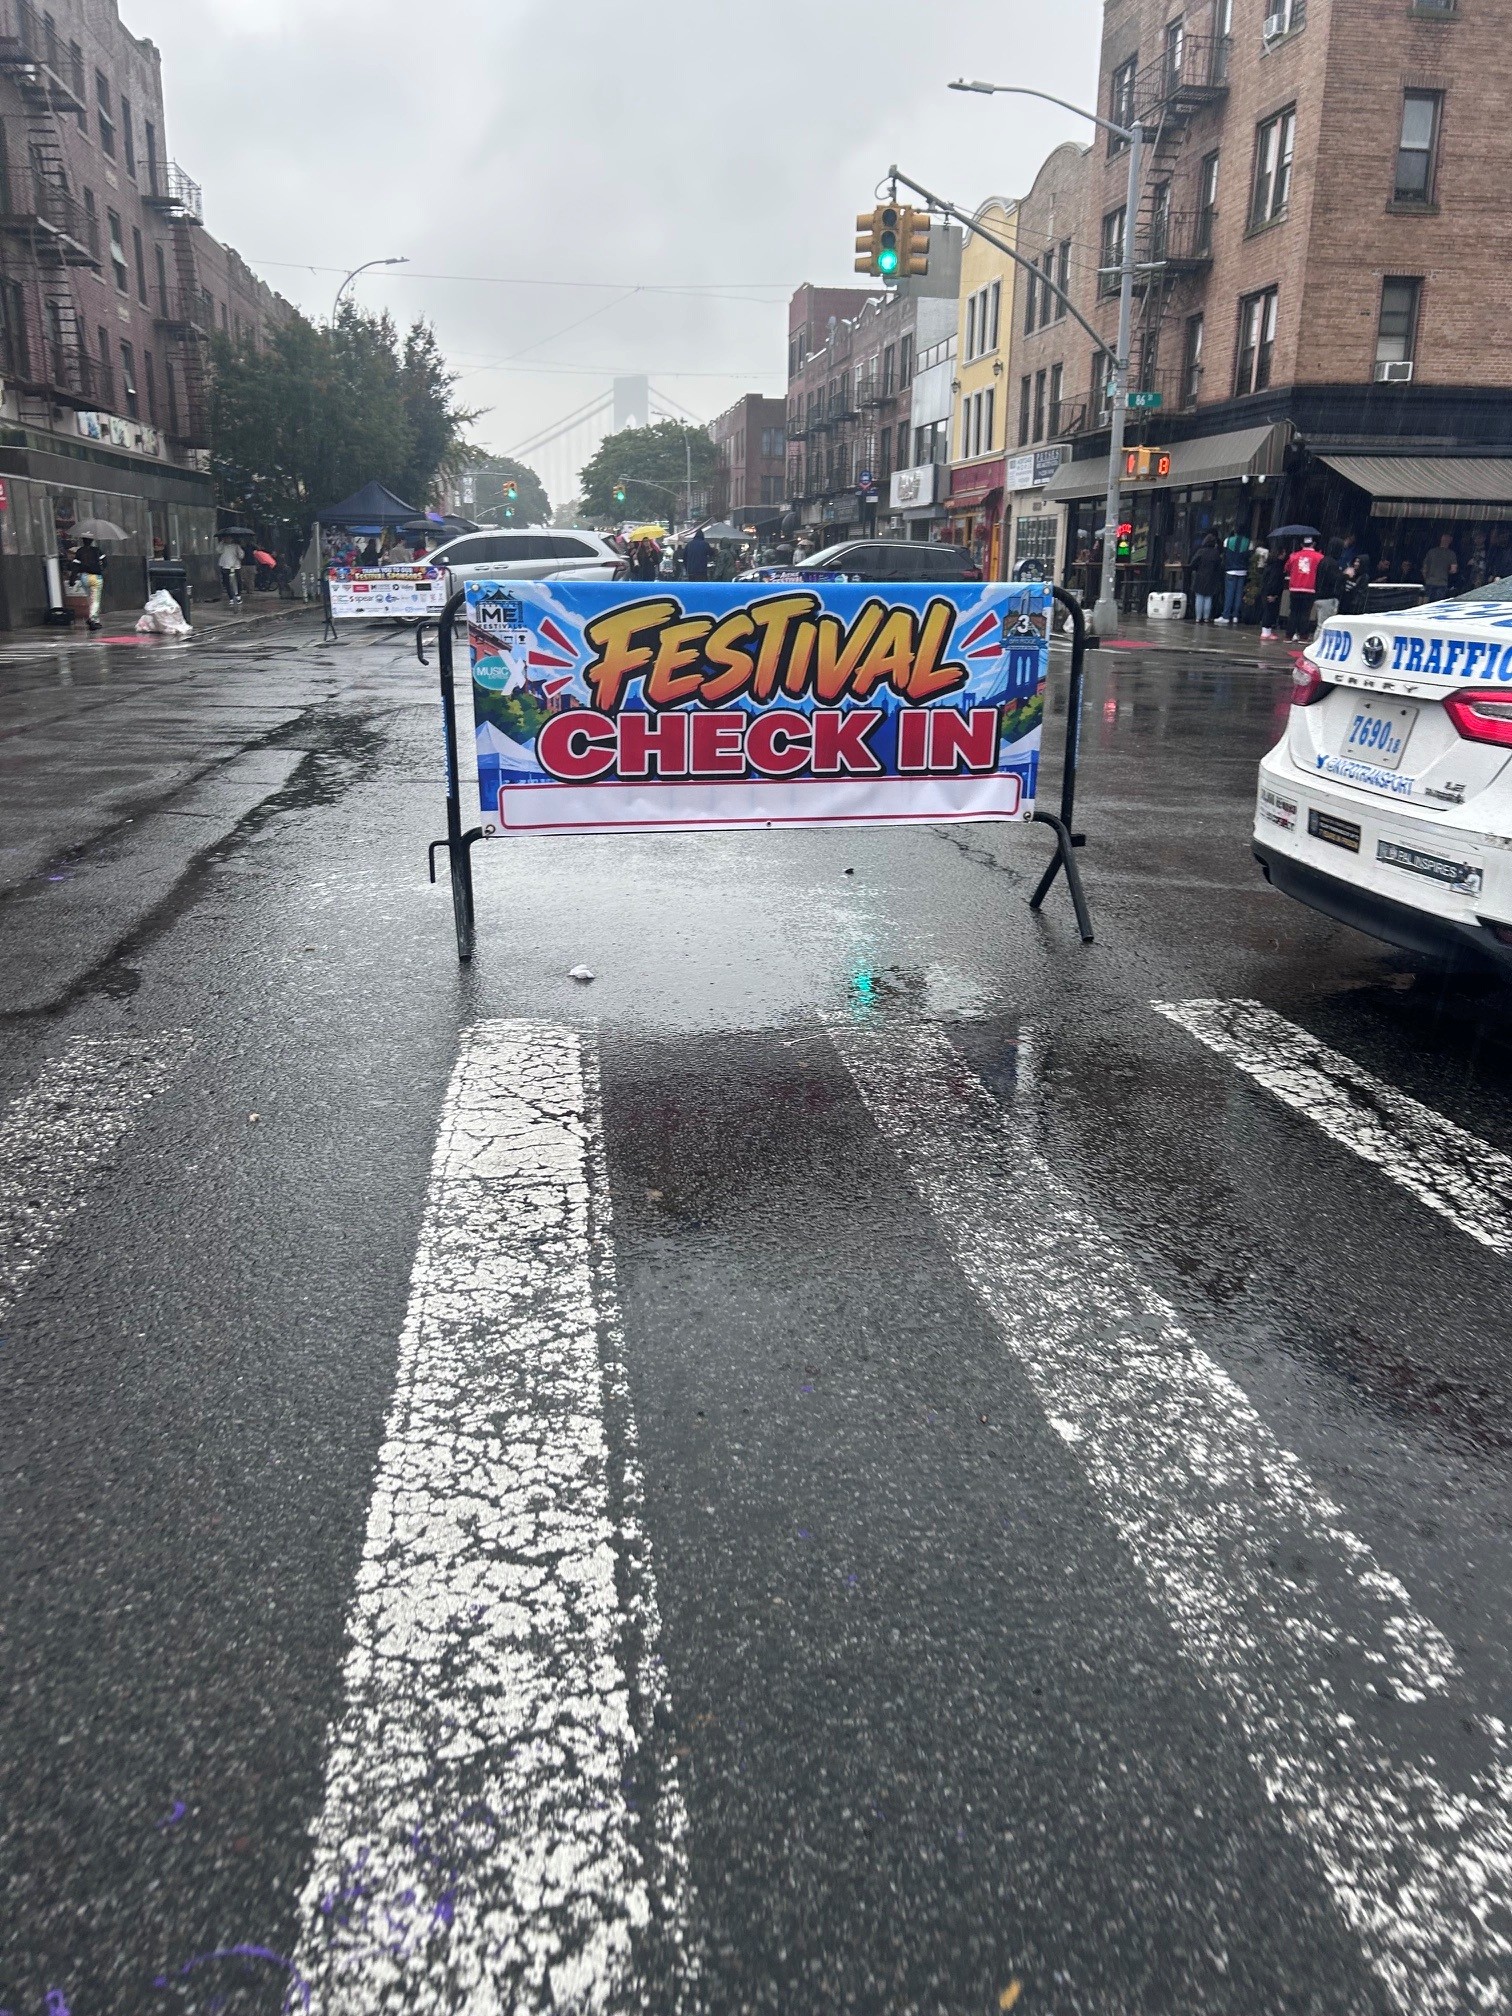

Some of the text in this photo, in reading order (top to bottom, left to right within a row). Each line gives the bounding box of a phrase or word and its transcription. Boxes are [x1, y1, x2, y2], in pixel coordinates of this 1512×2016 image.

[1135, 395, 1145, 405] 86
[482, 608, 517, 622] ME
[1016, 615, 1030, 633] 3
[585, 596, 966, 710] FESTIVAL
[1316, 628, 1512, 682] NYPD TRAFFIC
[476, 666, 509, 676] MUSIC
[539, 708, 882, 780] CHECK
[896, 708, 998, 772] IN
[1349, 714, 1393, 750] 7690
[1397, 850, 1412, 867] PAL
[1413, 855, 1459, 879] INSPIRES
